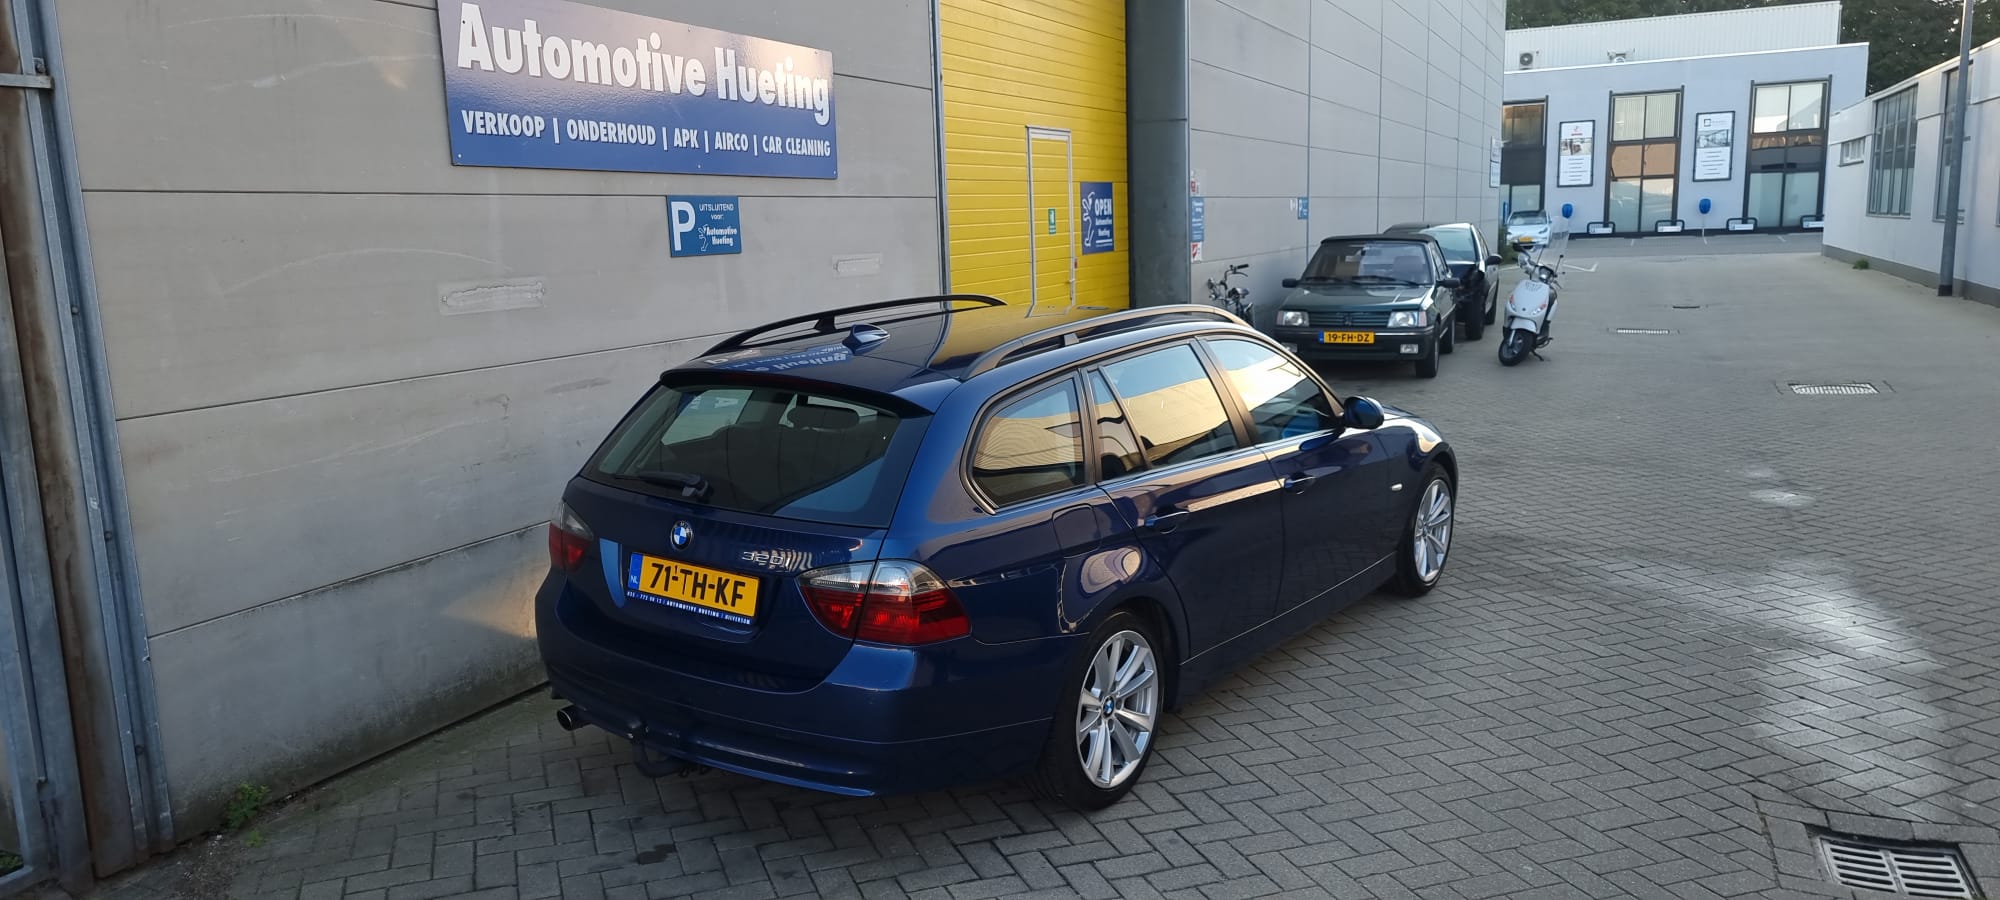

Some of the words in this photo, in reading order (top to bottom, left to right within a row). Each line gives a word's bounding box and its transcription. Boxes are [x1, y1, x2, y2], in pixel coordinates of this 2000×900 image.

[457, 2, 706, 96] Automotive
[714, 47, 830, 126] Hueting
[461, 109, 545, 138] VERKOOP
[566, 122, 656, 147] ONDERHOUD
[673, 127, 700, 150] APK
[714, 131, 749, 152] AIRCO
[762, 135, 783, 155] CAR
[785, 136, 831, 158] CLEANING
[698, 203, 734, 212] UITSLUITEND
[1095, 198, 1112, 216] OPEN
[671, 201, 696, 251] P
[706, 225, 738, 235] Automotive
[711, 235, 734, 247] Hueting
[1327, 333, 1370, 342] 19-FH-DZ
[630, 575, 639, 584] NL
[649, 562, 746, 607] 71-TH-KF
